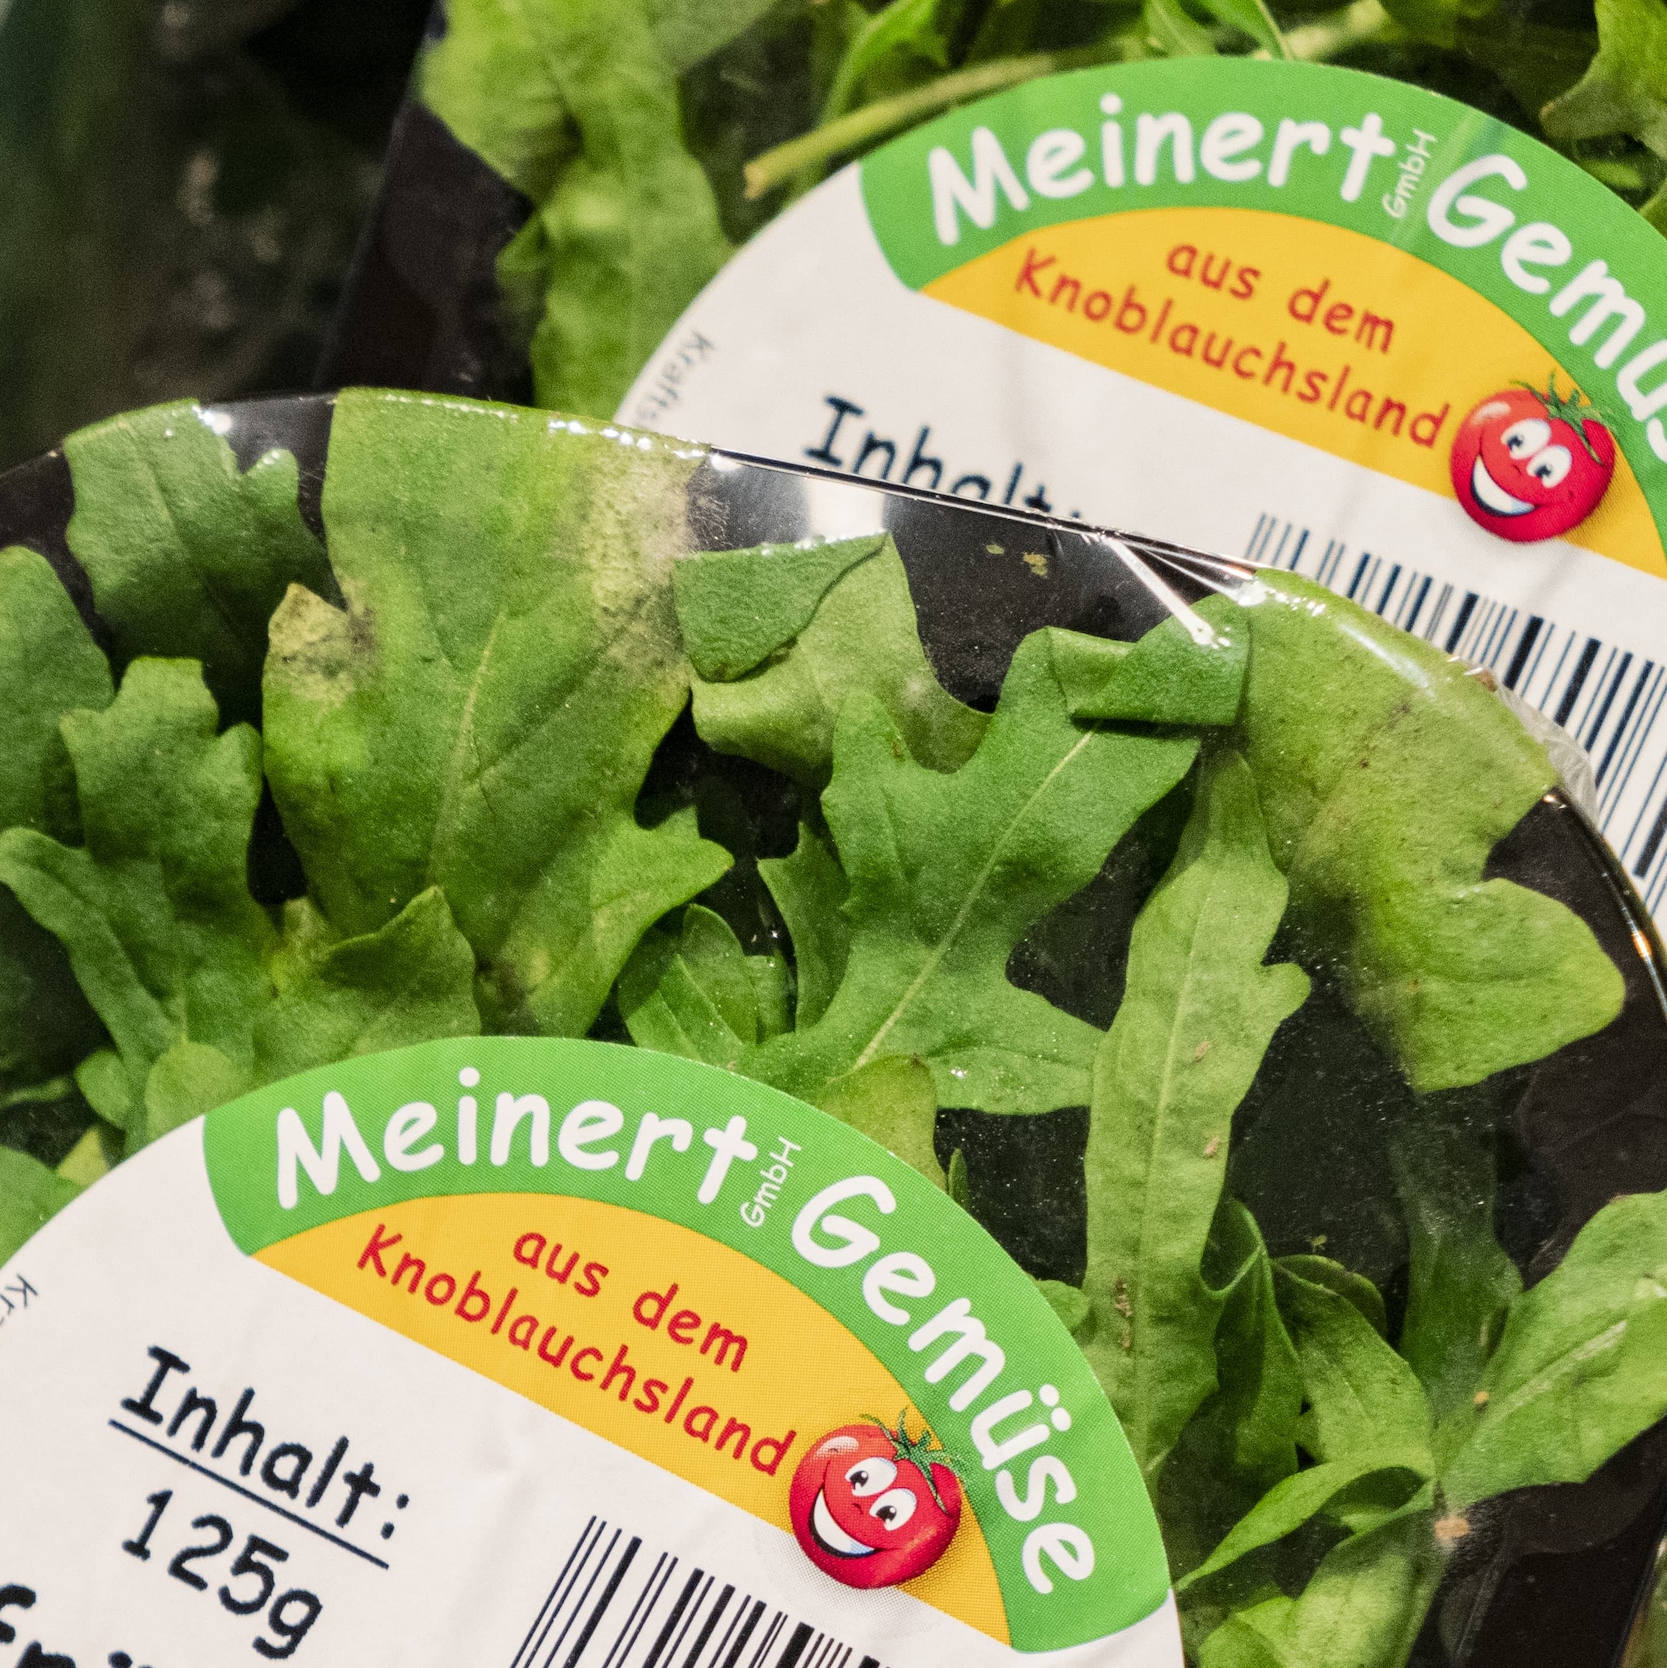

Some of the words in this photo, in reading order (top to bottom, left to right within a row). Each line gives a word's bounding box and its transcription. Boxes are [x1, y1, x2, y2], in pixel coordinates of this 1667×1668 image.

[927, 94, 1396, 246] Meinert
[1382, 128, 1437, 219] GmbH
[1427, 154, 1667, 462] Gem
[1014, 247, 1452, 450] Knoblauchsland
[1165, 243, 1260, 301] aus
[1287, 277, 1396, 354] dem
[277, 1067, 756, 1209] Meinert
[739, 1136, 803, 1230] GmbH
[792, 1176, 1095, 1595] Gemüse
[355, 1223, 798, 1478] Knoblauchsland
[512, 1231, 610, 1298] aus
[632, 1282, 751, 1373] dem
[120, 1345, 409, 1539] Inhalt:
[121, 1489, 323, 1659] 125g
